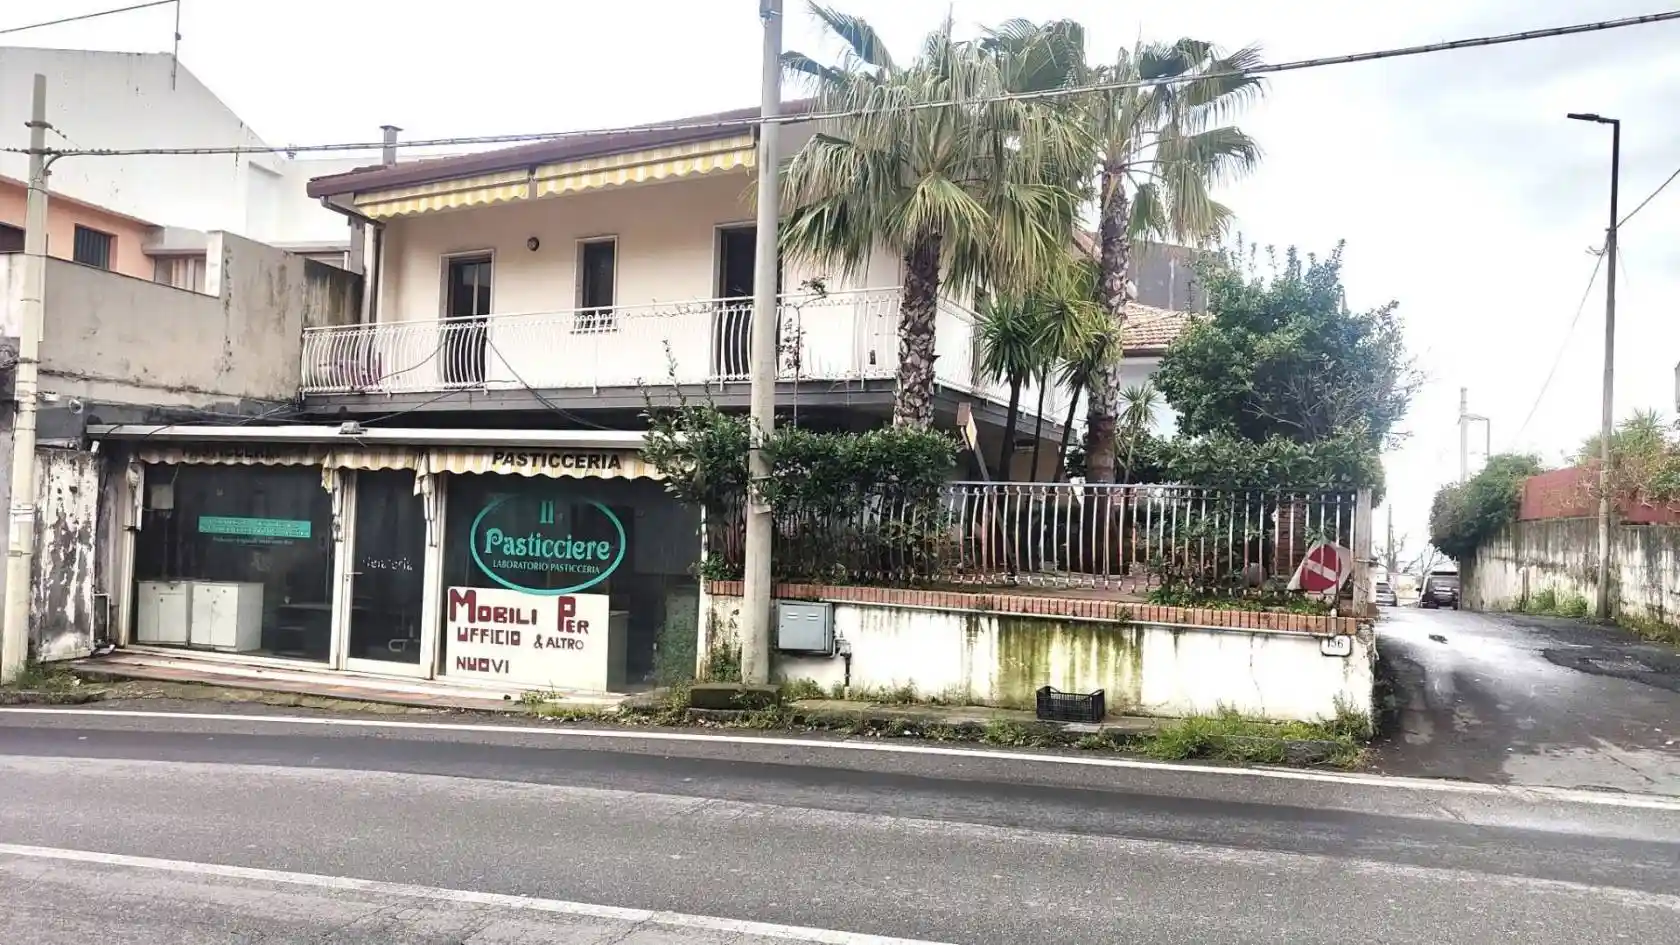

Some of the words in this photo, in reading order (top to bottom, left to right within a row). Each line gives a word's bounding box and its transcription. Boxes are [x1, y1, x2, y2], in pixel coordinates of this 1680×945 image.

[491, 451, 622, 469] PASTICCERIA
[484, 527, 610, 560] Pasticciere
[492, 559, 548, 571] LABORATORIO
[550, 562, 601, 574] PASTICCERIA
[457, 627, 521, 646] UFFICIO
[545, 636, 584, 650] ALTRO
[456, 655, 510, 673] NUOVI
